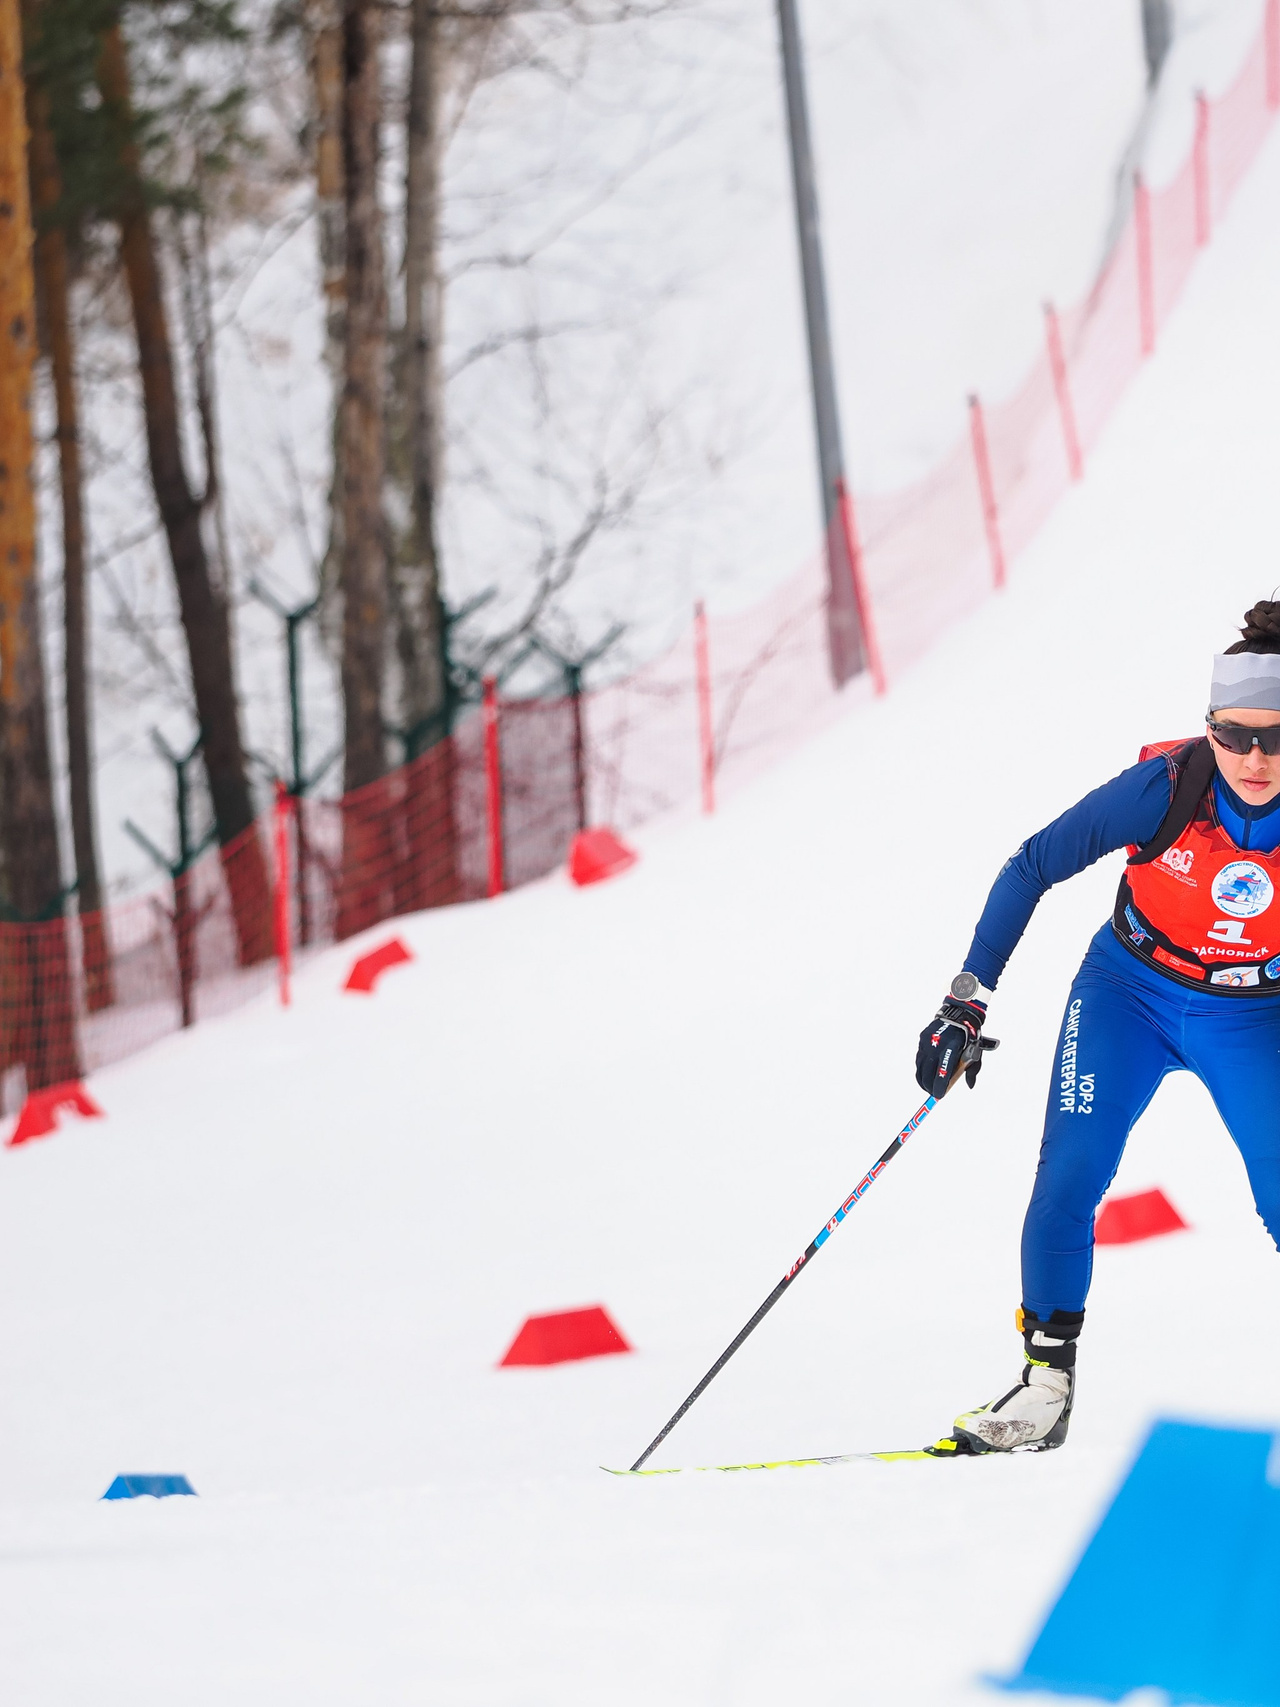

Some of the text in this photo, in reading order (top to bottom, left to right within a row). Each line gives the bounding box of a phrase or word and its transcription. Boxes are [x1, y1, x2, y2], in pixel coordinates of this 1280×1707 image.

[1207, 920, 1253, 945] 1
[1191, 946, 1269, 958] РАСНОЯРСК
[1060, 999, 1082, 1113] САНКТ-ПЕТЕРБУРГ
[1077, 1073, 1095, 1114] УОР-2
